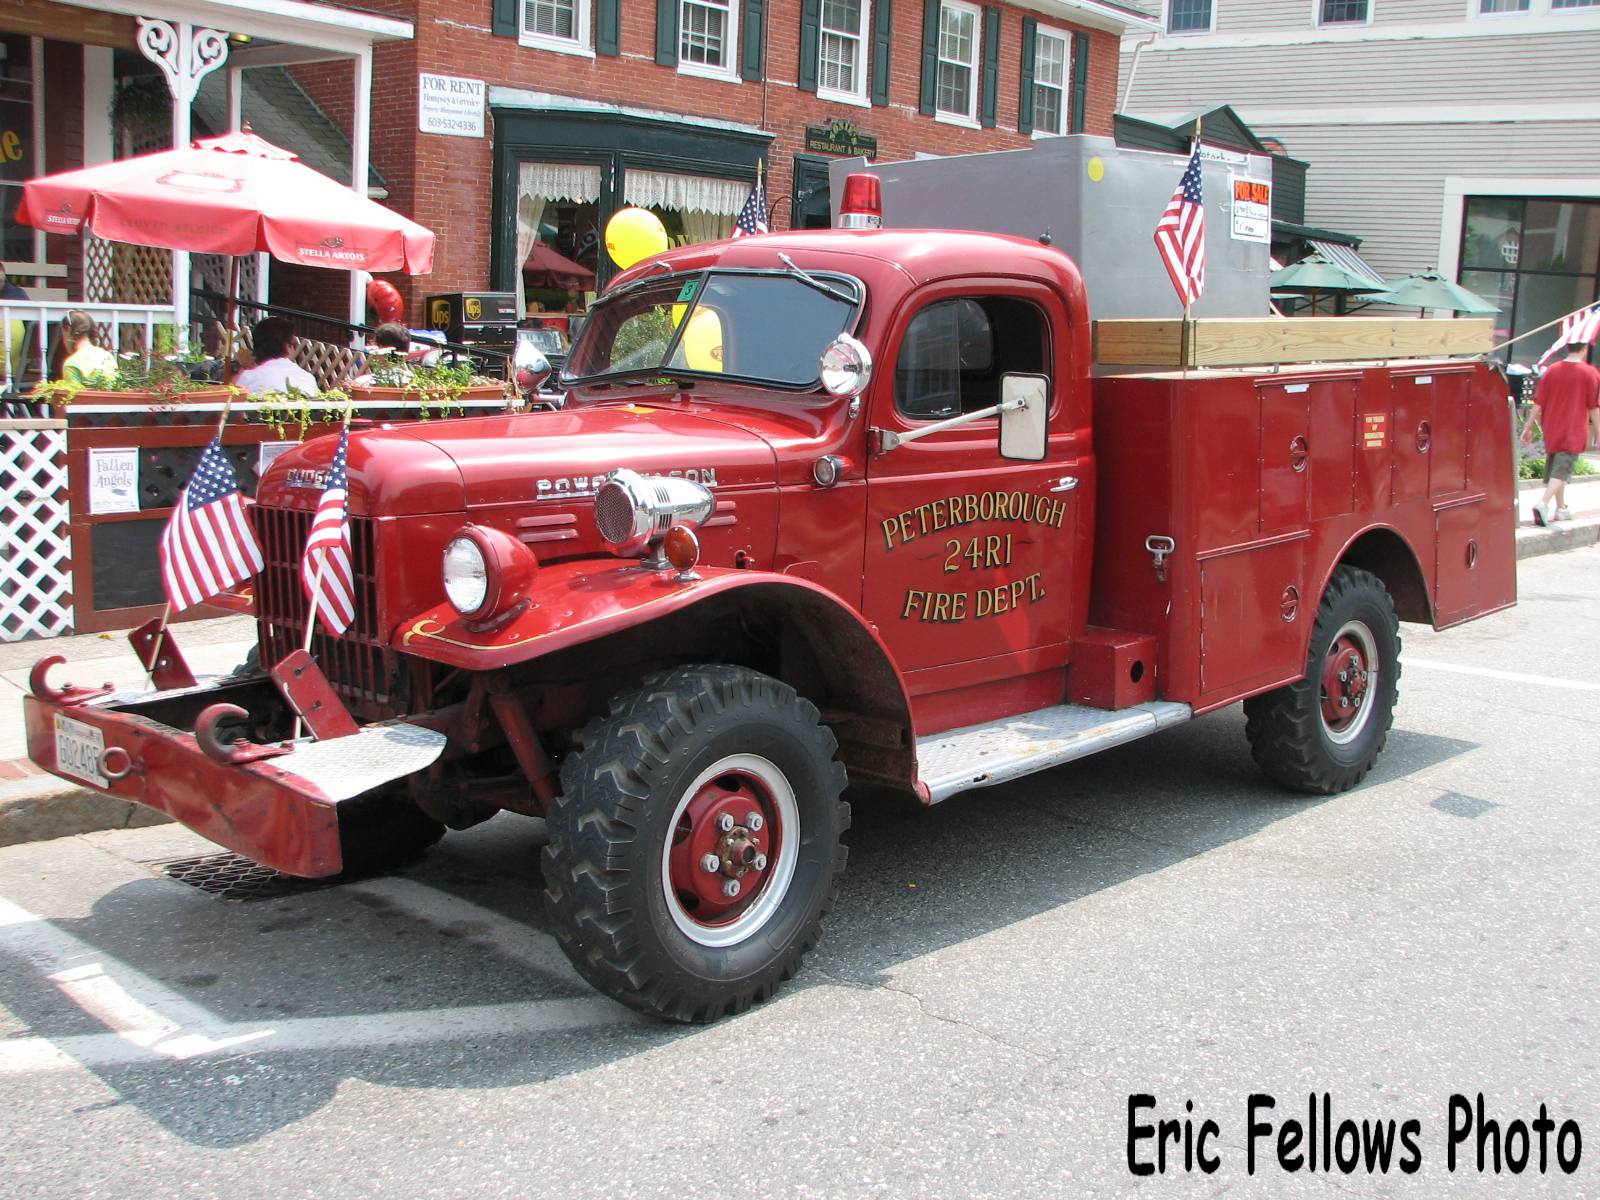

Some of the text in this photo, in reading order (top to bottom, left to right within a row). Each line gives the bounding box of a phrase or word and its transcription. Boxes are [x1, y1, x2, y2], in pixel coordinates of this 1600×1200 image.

[423, 77, 482, 95] FOR RENT
[809, 140, 846, 153] RESTAURANT
[853, 146, 875, 158] BAKERY
[1235, 181, 1269, 205] FOR SALE
[297, 247, 366, 261] STELLA ARTOIS
[96, 458, 134, 472] Fallen
[95, 472, 132, 488] Angels
[882, 491, 1066, 549] PETERBOROUGH
[903, 572, 1046, 621] FIRE DEPT.
